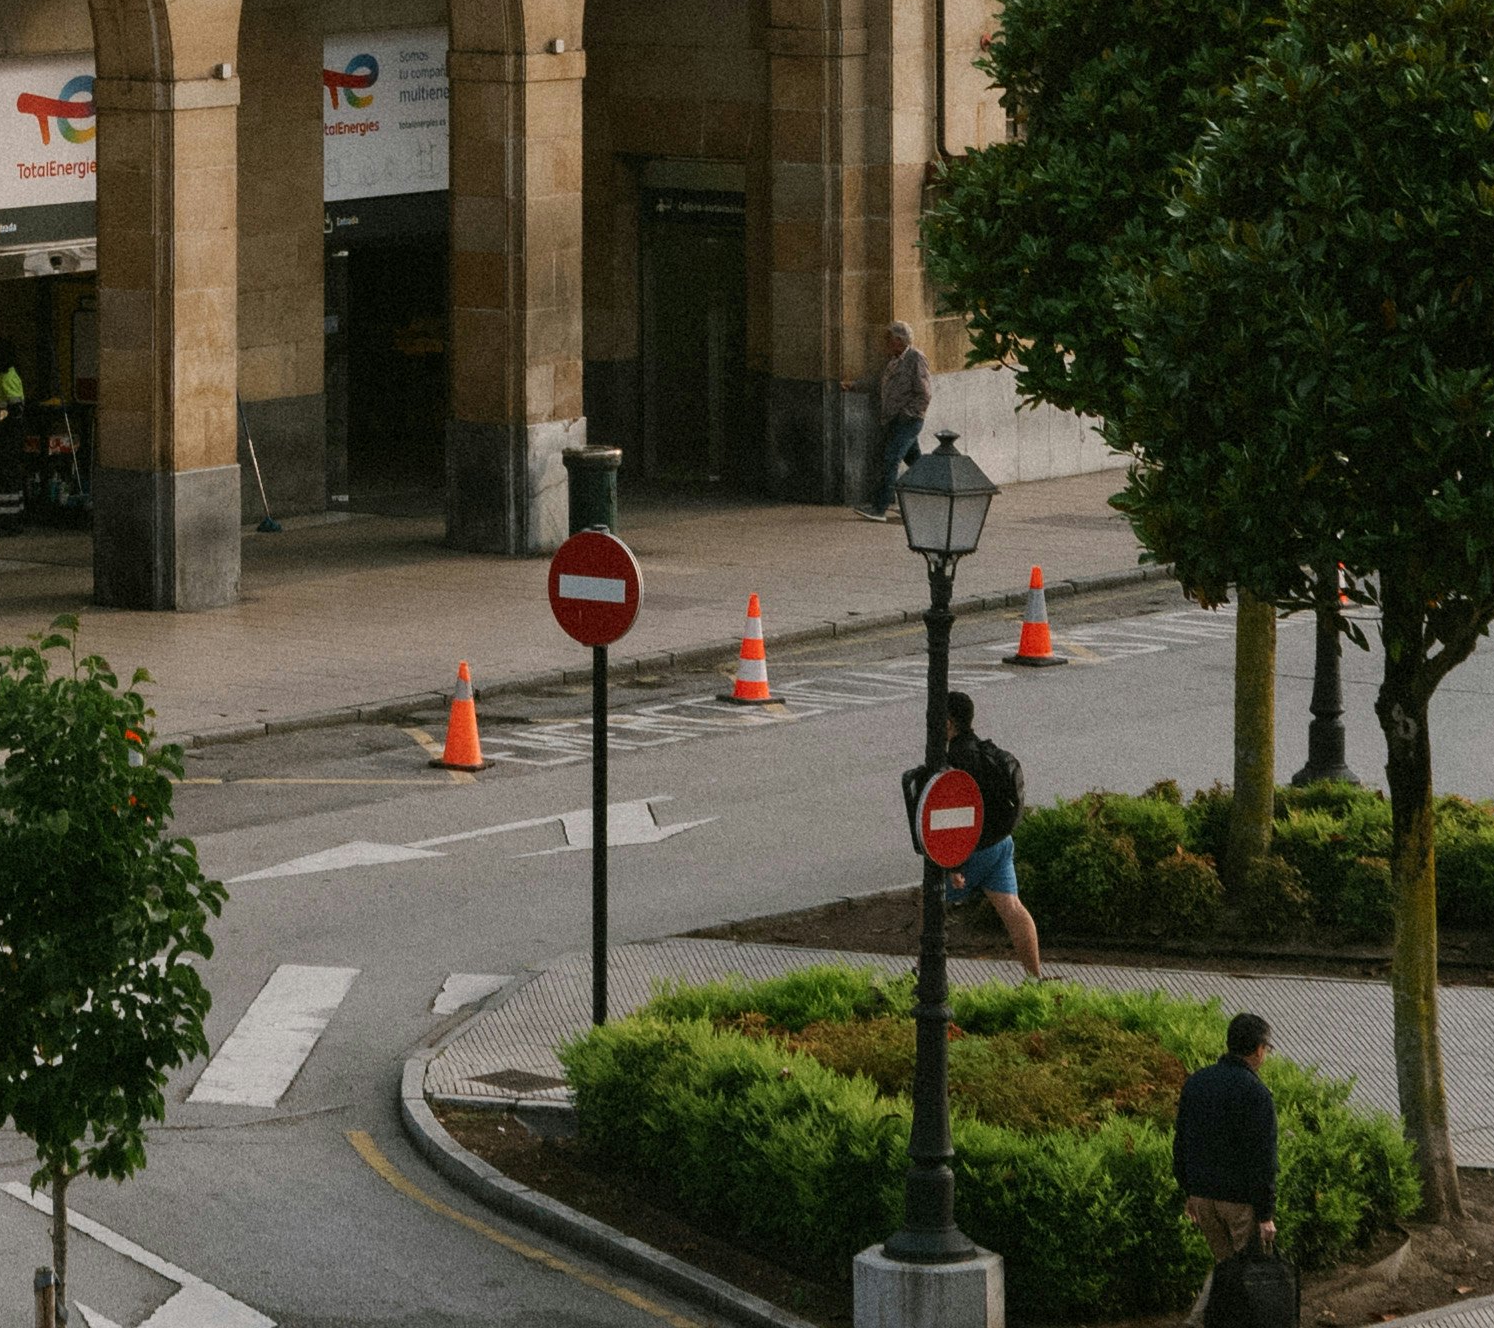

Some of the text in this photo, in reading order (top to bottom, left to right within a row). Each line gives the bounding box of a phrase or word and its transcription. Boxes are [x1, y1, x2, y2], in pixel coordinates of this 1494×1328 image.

[399, 50, 429, 63] Somos
[399, 86, 450, 103] multiene
[324, 118, 380, 137] talEnergies
[16, 157, 97, 180] TotalEnergie
